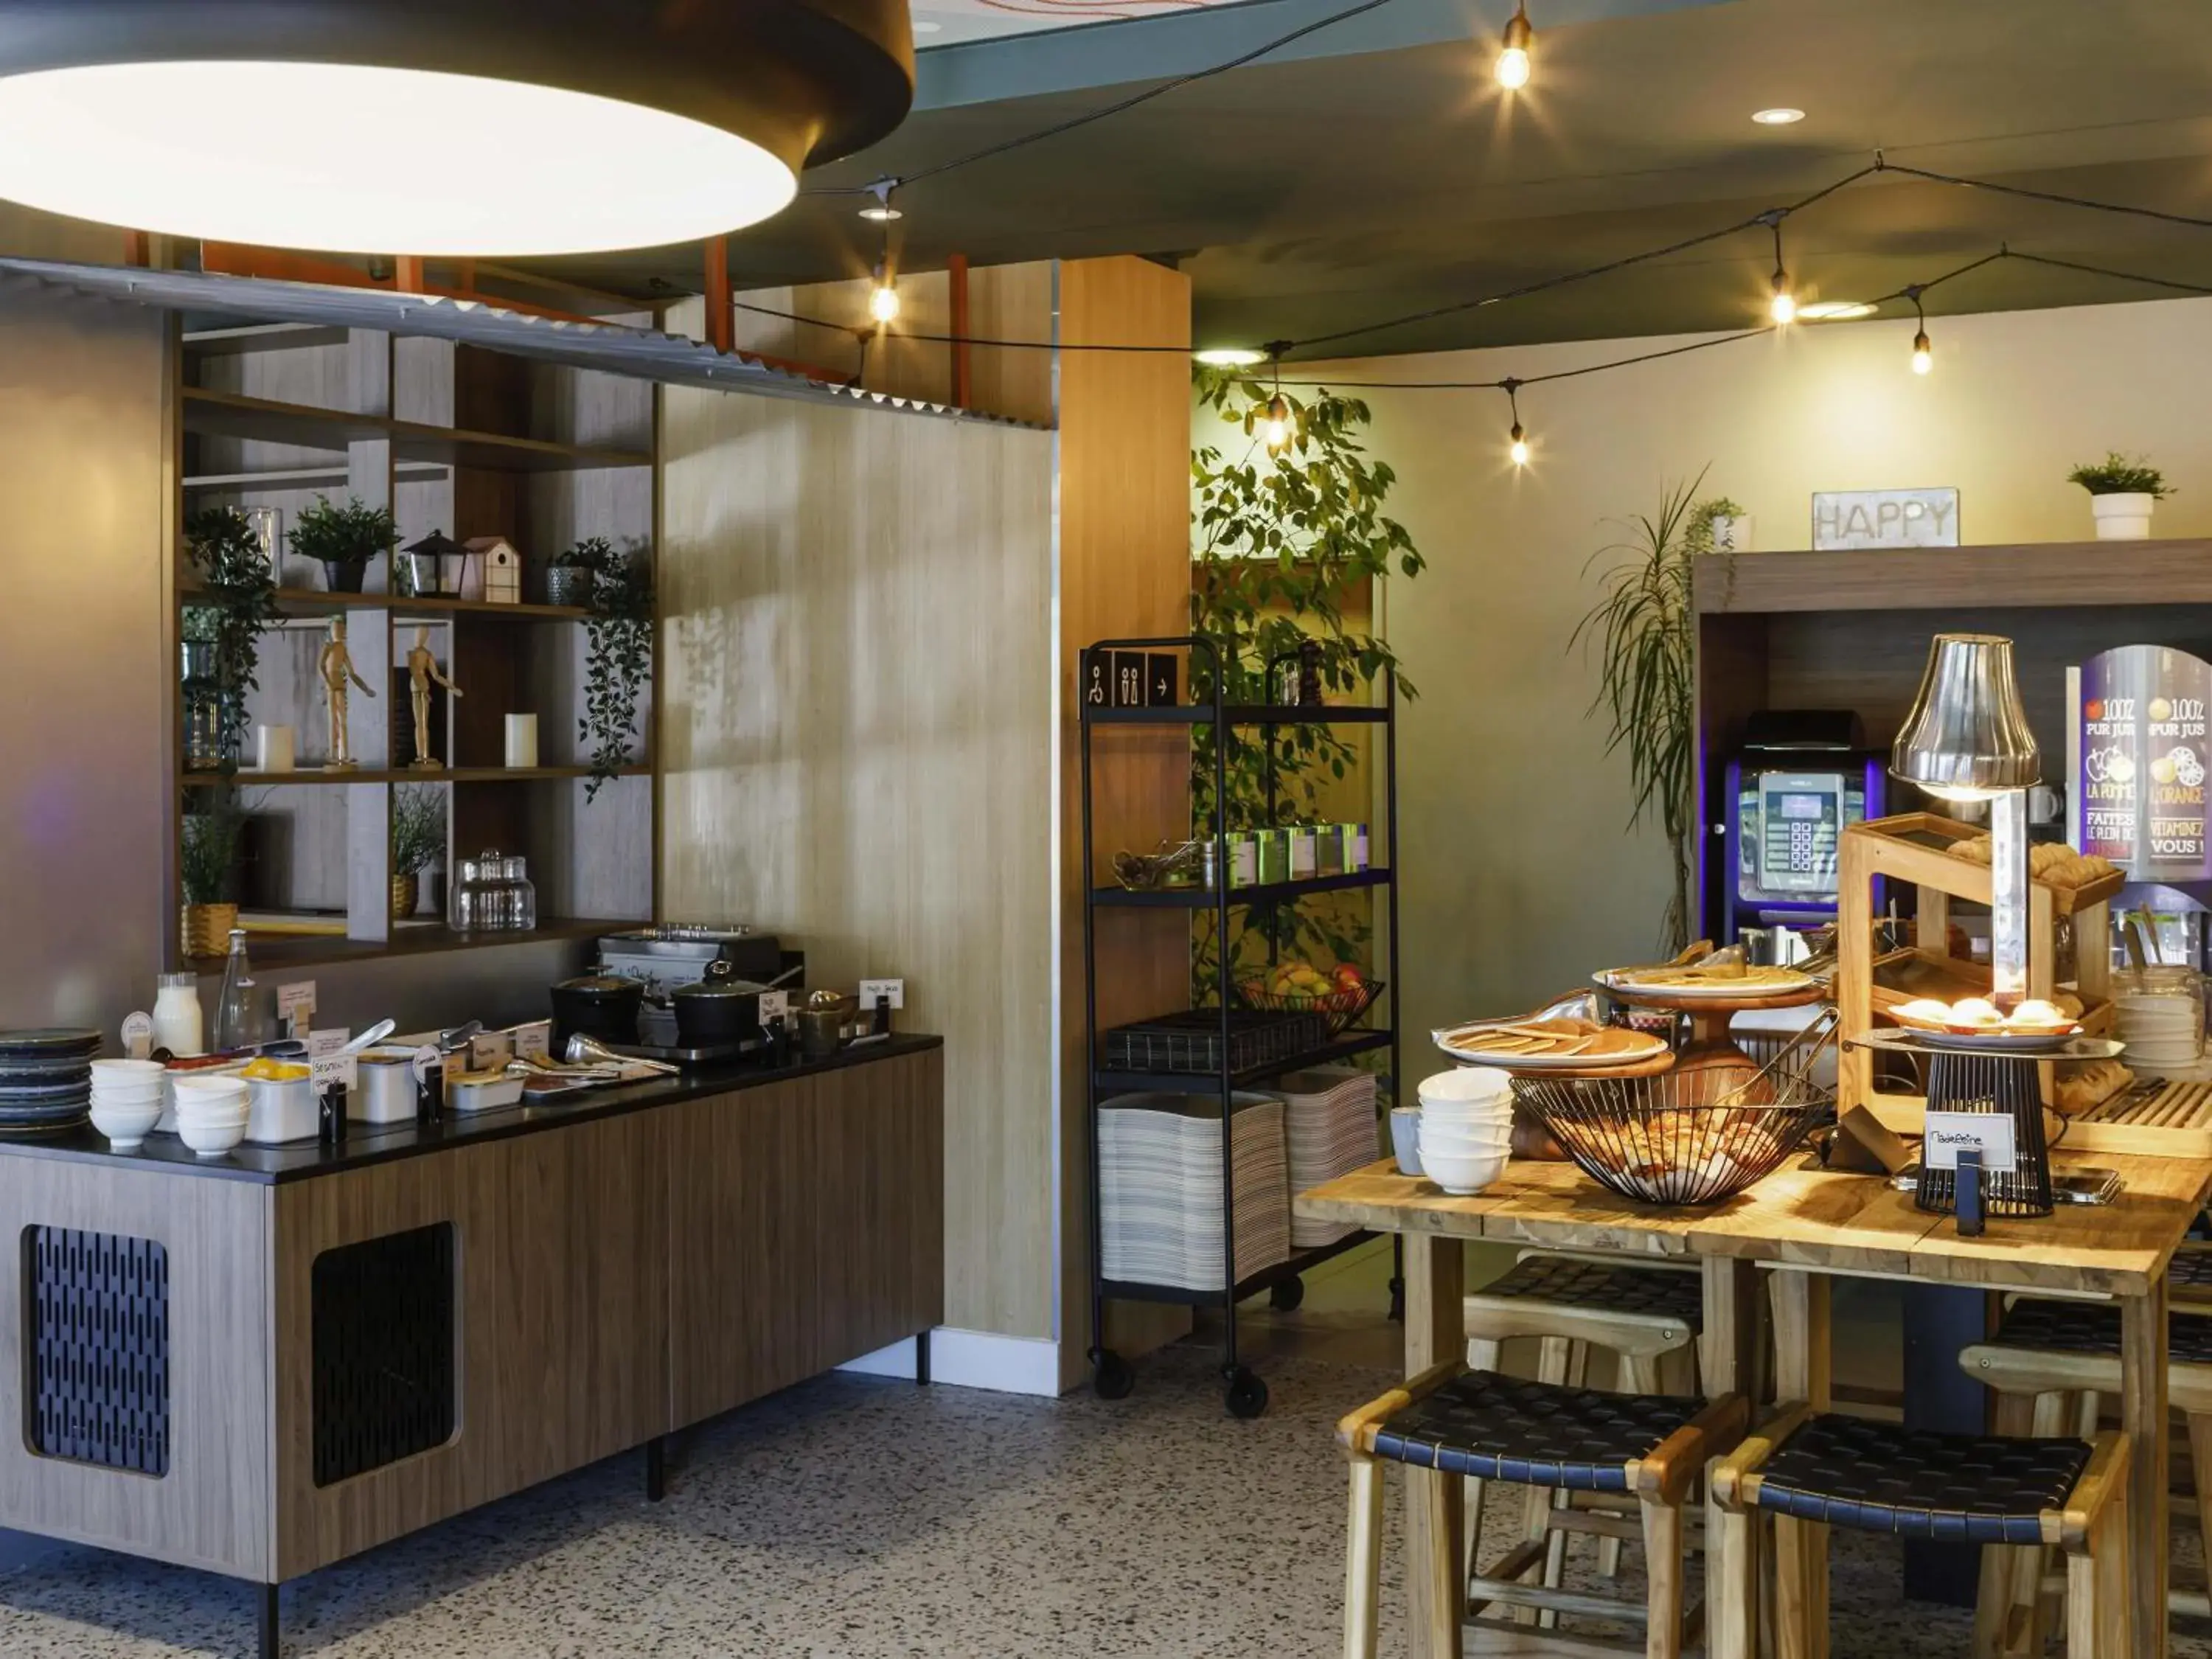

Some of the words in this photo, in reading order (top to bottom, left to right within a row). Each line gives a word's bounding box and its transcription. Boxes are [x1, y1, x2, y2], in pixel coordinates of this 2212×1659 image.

[1816, 501, 1952, 540] HAPPY
[2102, 698, 2135, 720] 100%
[2171, 698, 2205, 720] 100%
[2087, 723, 2111, 735] PUR
[2149, 723, 2179, 736] PUR
[2180, 723, 2205, 739] JUS
[2087, 812, 2135, 825] FAITES
[2151, 839, 2196, 853] VOUS
